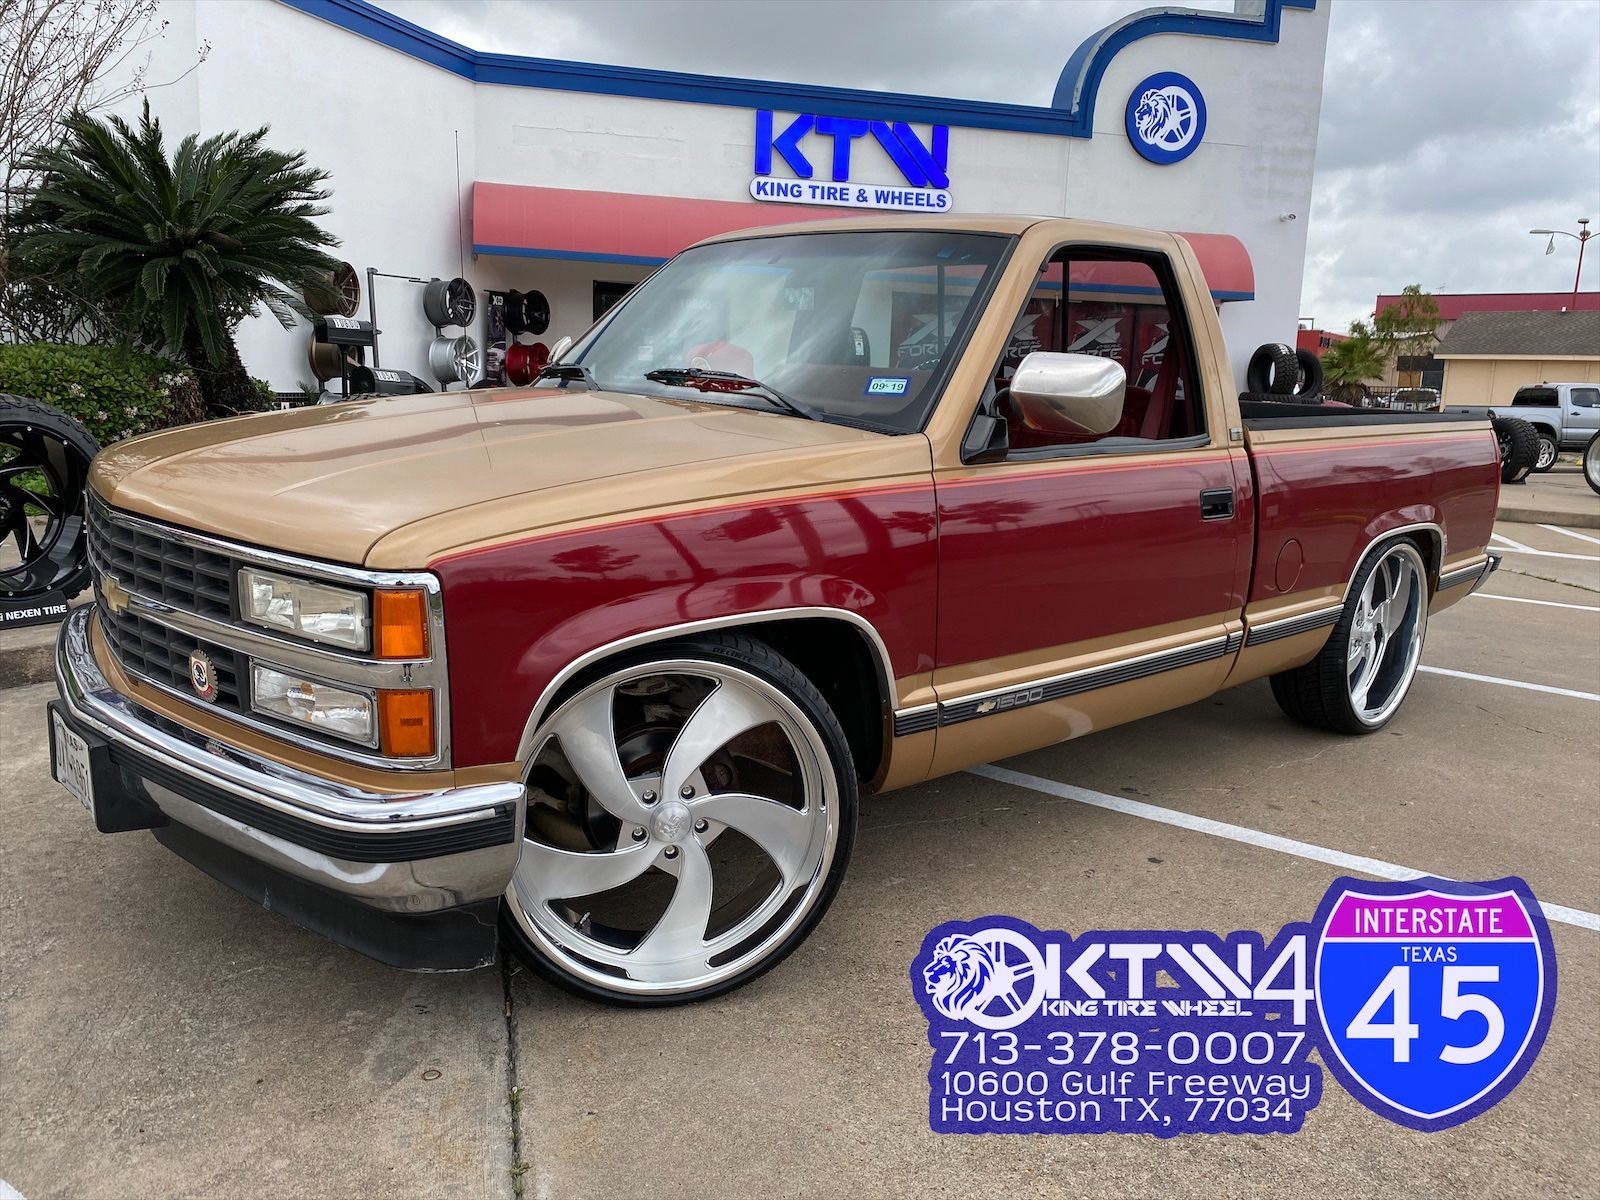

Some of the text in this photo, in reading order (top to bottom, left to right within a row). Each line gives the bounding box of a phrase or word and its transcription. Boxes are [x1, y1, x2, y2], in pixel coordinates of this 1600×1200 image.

[755, 109, 949, 189] KTW
[756, 181, 947, 208] KING TIRE & WHEELS
[872, 382, 904, 391] 09 19
[5, 604, 67, 621] NEXEN TIRE
[996, 688, 1043, 709] 1500
